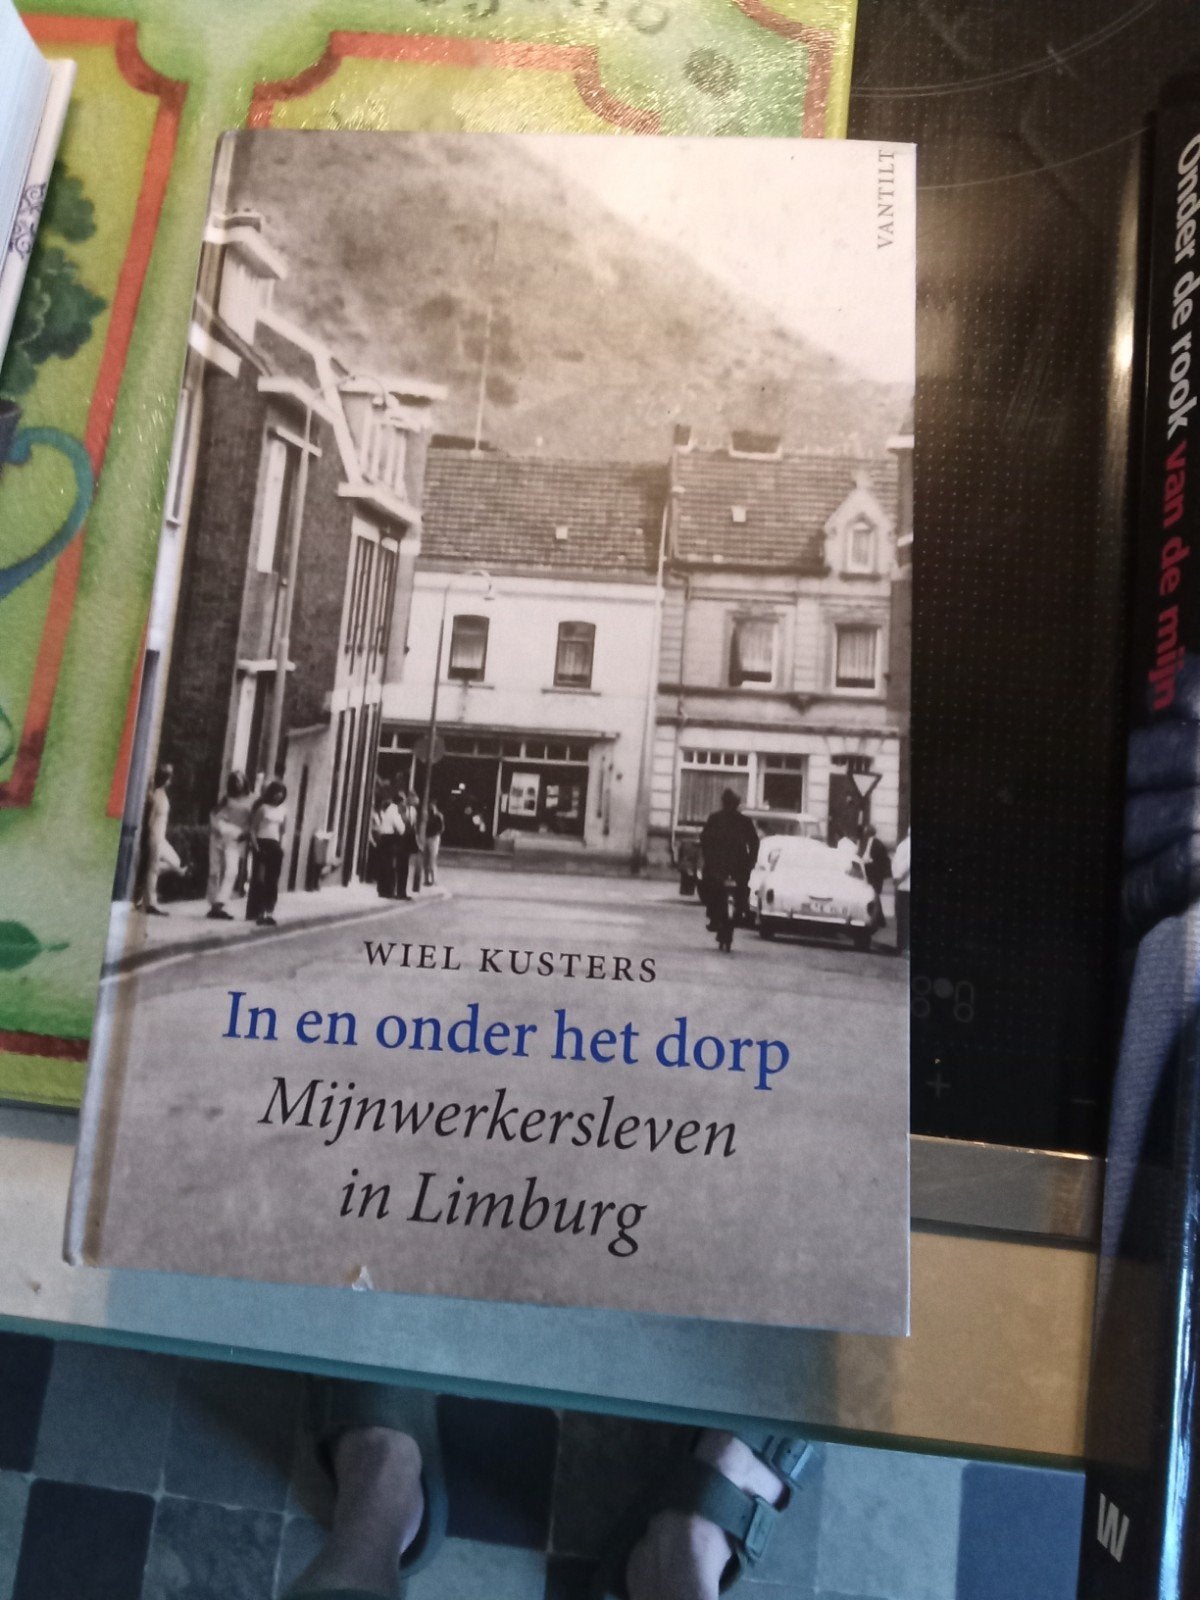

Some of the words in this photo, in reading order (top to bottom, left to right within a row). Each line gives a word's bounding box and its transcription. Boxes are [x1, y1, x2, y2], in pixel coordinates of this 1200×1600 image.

[877, 149, 895, 249] VANTILT
[1175, 134, 1200, 264] Onder
[1172, 271, 1200, 330] de
[1167, 331, 1198, 440] rook
[1163, 439, 1187, 529] van
[1159, 536, 1191, 596] de
[1148, 605, 1186, 712] mijn
[364, 941, 462, 972] WIEL
[479, 948, 658, 983] KUSTERS
[222, 990, 279, 1041] In
[296, 1009, 359, 1047] en
[375, 1003, 538, 1058] onder
[551, 1009, 640, 1065] het
[655, 1017, 791, 1091] dorp
[257, 1076, 738, 1158] Mijnwerkersleven
[339, 1168, 391, 1221] in
[406, 1172, 648, 1258] Limburg
